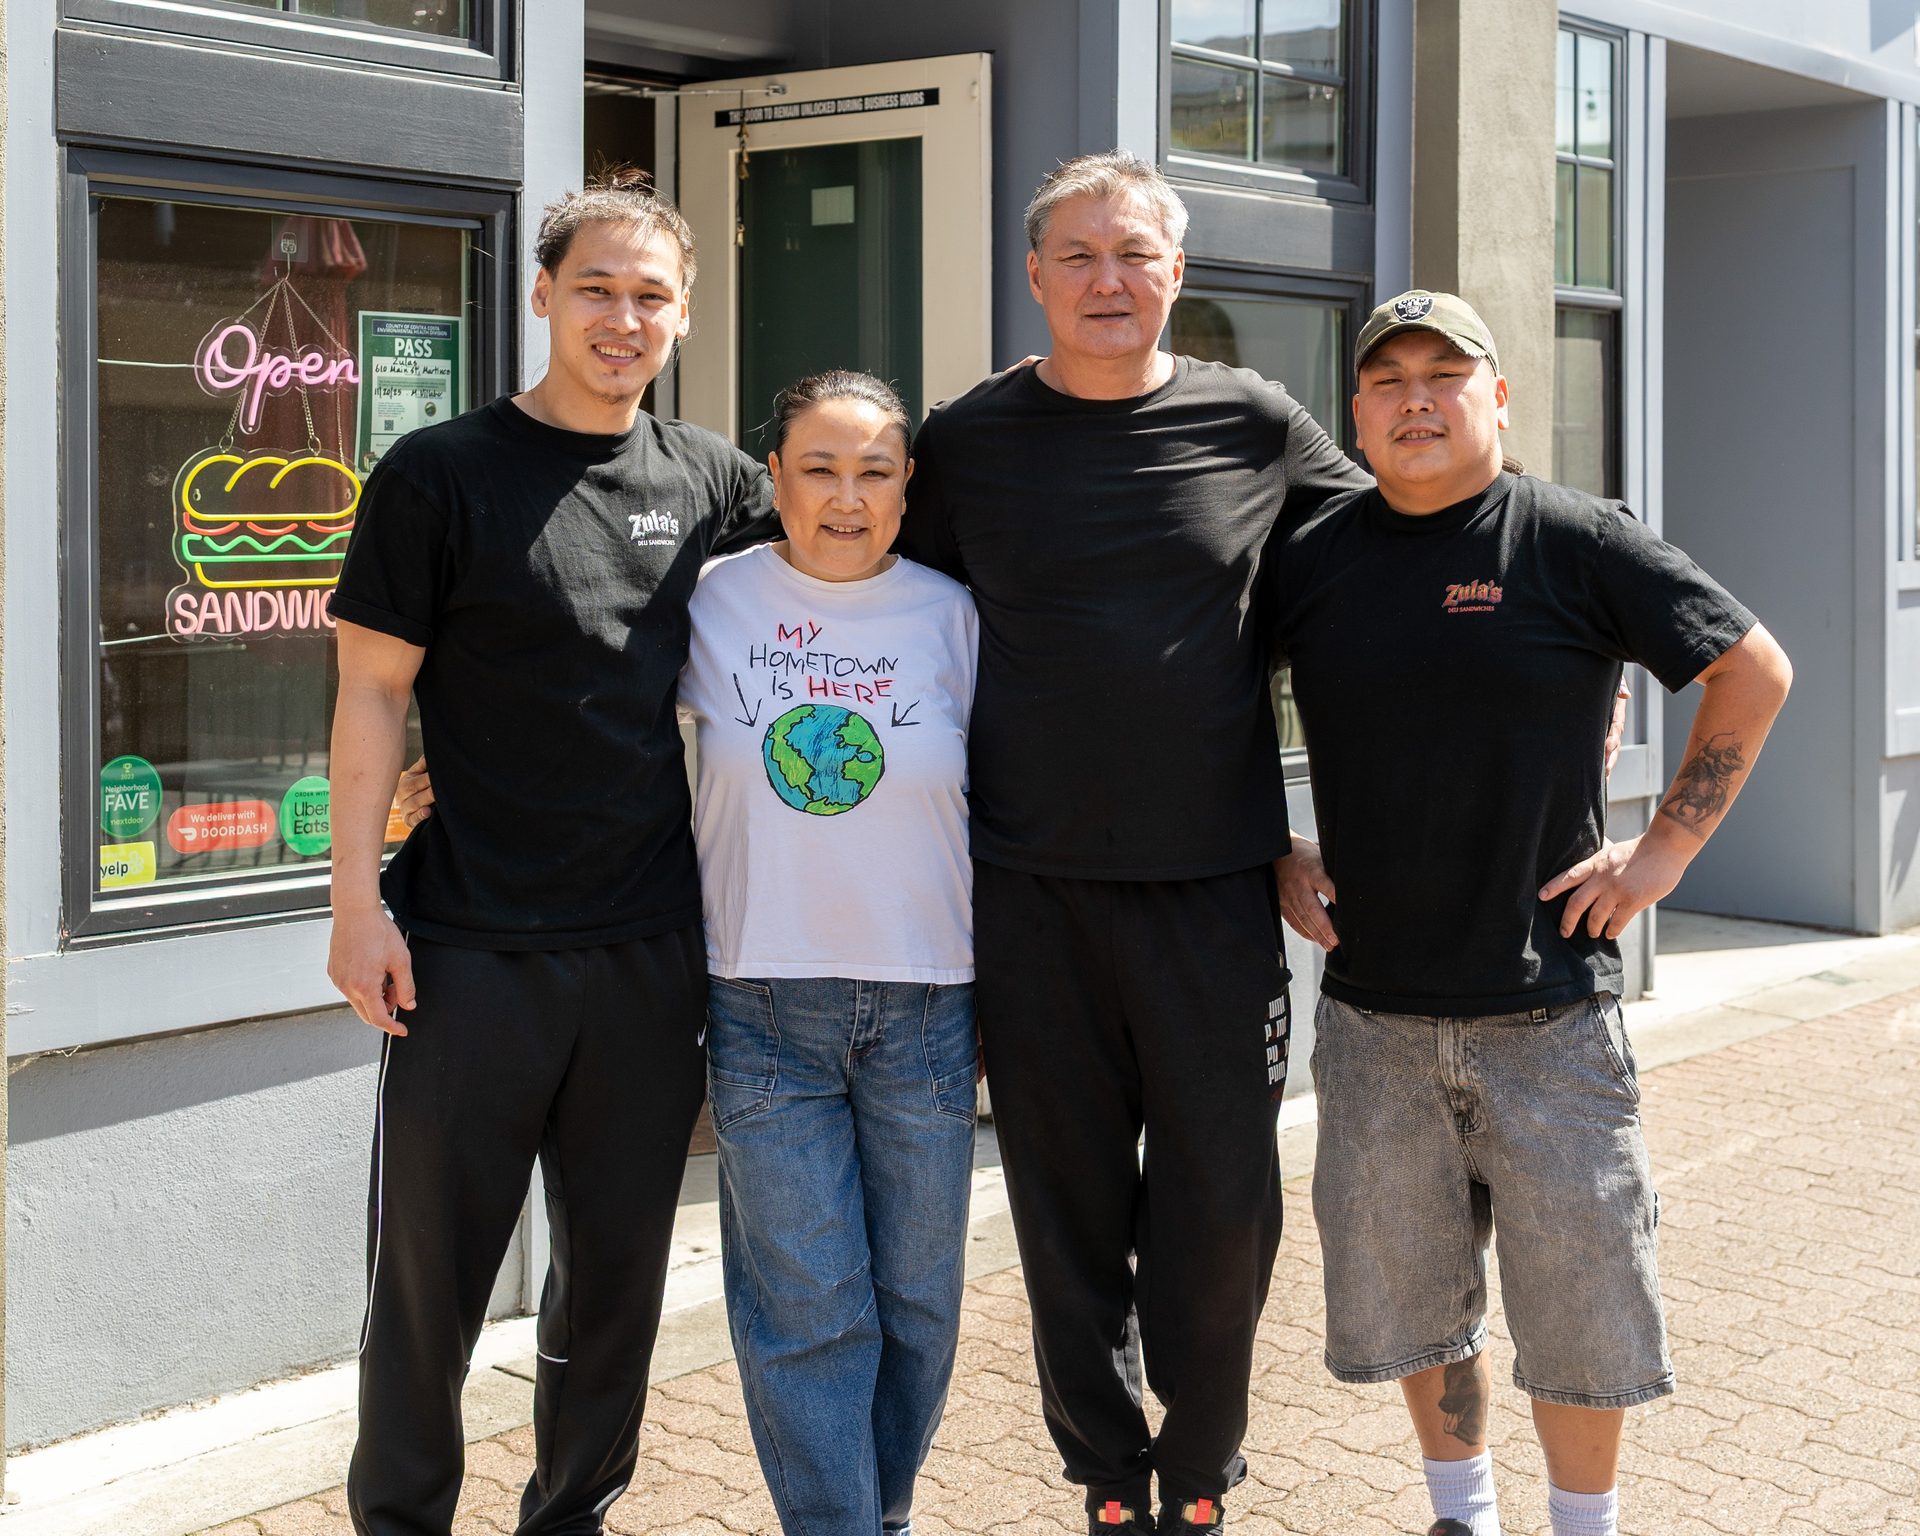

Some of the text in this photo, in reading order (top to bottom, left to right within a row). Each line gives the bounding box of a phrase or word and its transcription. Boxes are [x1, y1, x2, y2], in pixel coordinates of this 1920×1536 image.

[800, 101, 836, 116] UNLOCKED
[837, 98, 863, 112] DURING
[864, 94, 899, 110] BUSINESS
[899, 91, 925, 106] HOURS
[394, 338, 433, 358] PASS
[204, 324, 359, 426] Open
[375, 364, 388, 373] 610
[628, 509, 679, 540] Zula's
[1441, 579, 1503, 608] Zula's
[777, 621, 823, 648] MY
[749, 643, 899, 677] HOMETOWN
[807, 675, 894, 704] HERE
[105, 783, 149, 794] Neighborhood
[105, 792, 150, 812] FAVE
[294, 801, 329, 817] Uber
[110, 816, 144, 826] nextdoor
[190, 810, 256, 823] We deliver with
[201, 823, 268, 838] DOORDASH
[294, 819, 329, 835] Eats
[100, 861, 128, 878] yelp
